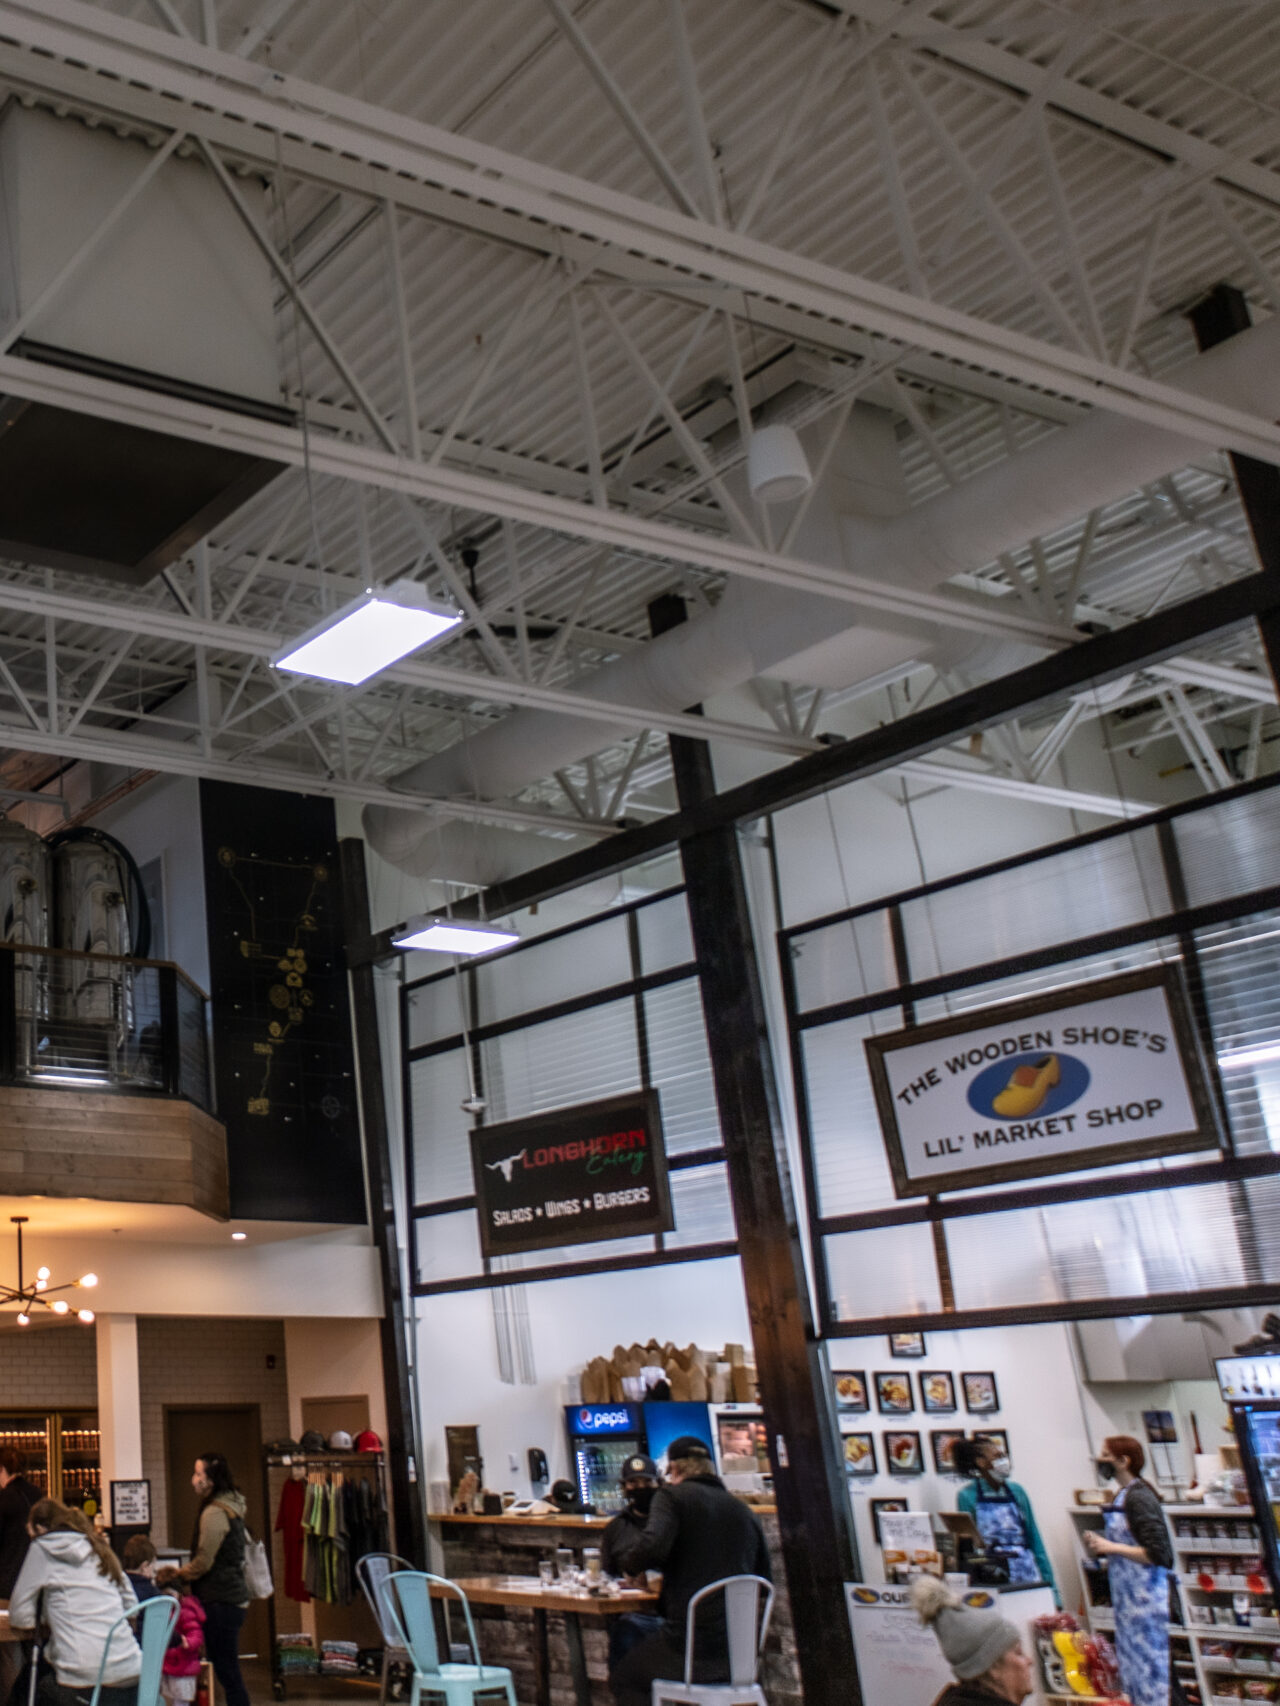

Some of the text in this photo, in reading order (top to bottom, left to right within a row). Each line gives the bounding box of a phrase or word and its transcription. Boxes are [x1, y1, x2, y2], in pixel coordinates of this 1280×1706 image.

[897, 1027, 1169, 1107] THE WOODEN SHOE'S
[924, 1098, 1164, 1159] LIL' MARKET SHOP
[522, 1129, 648, 1169] LONGHORN
[586, 1146, 648, 1175] Eatery
[493, 1186, 651, 1227] SALADS WINGS BURGERS
[594, 1408, 629, 1428] pepsi
